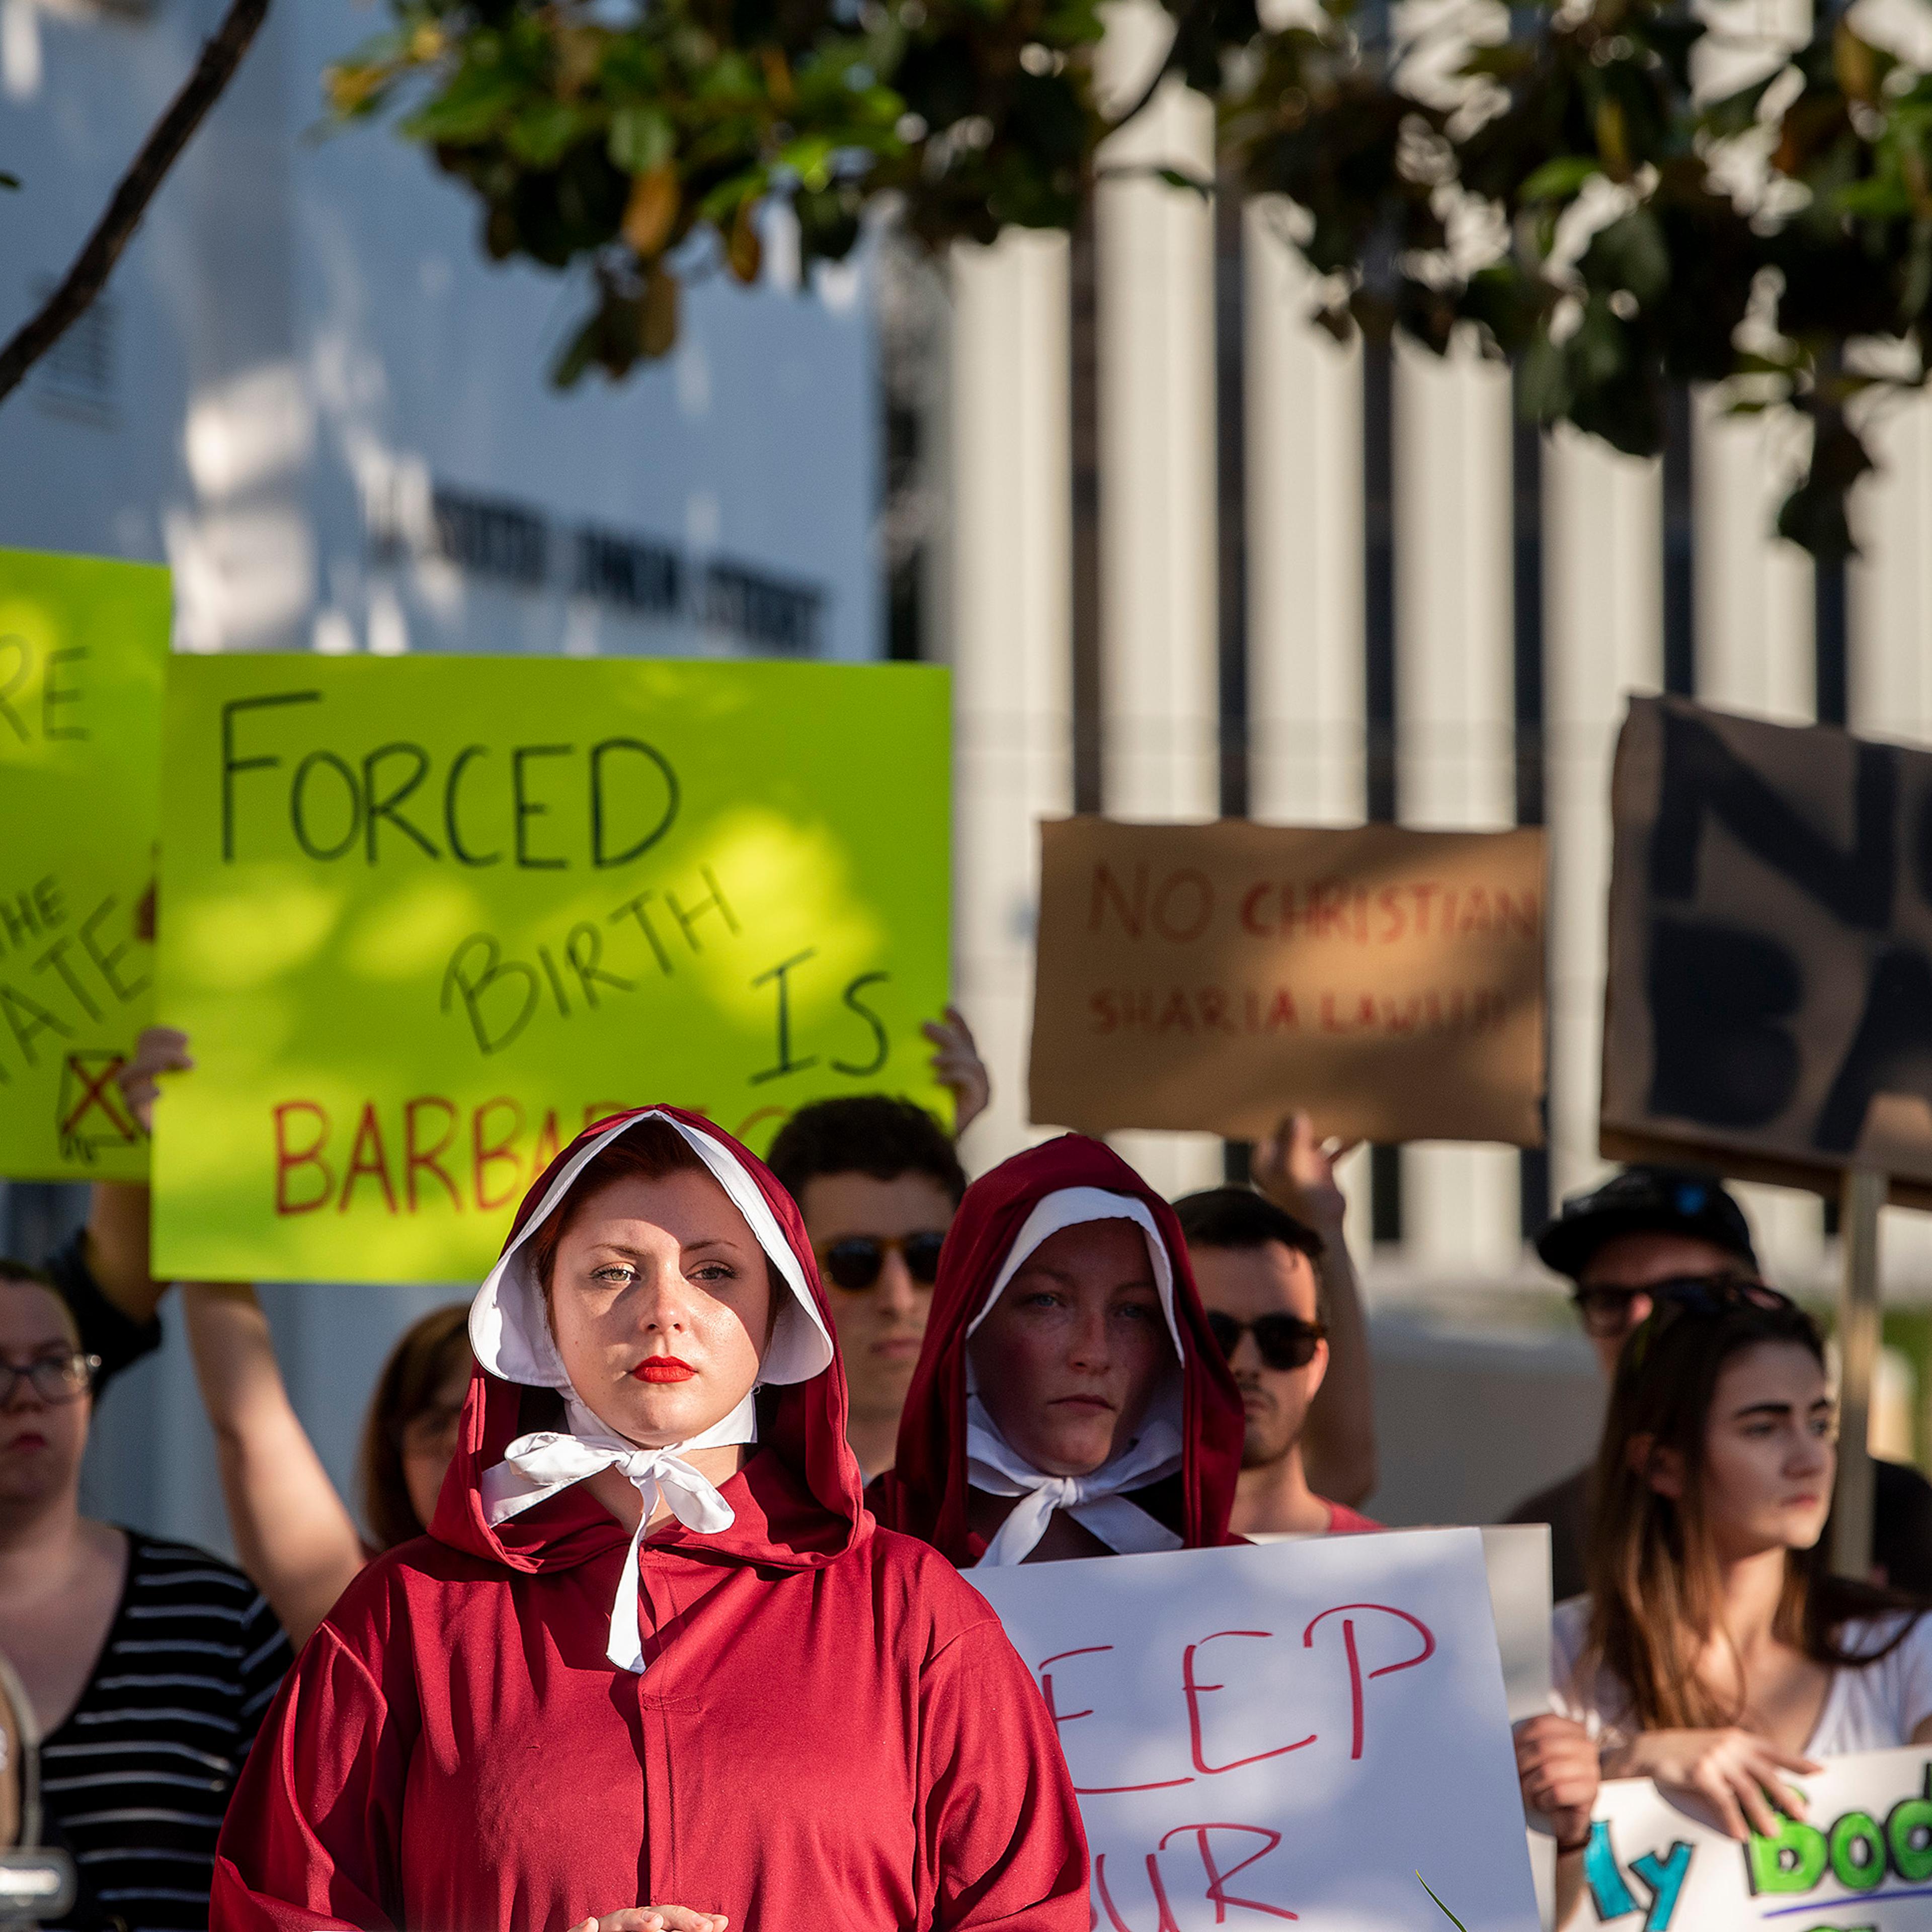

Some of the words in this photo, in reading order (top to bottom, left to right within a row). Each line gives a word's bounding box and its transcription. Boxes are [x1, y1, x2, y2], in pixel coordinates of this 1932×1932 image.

[220, 690, 681, 870] FORCED
[1648, 708, 1932, 935] N
[0, 874, 68, 951] HE
[439, 863, 742, 1057] BIRTH
[1088, 863, 1209, 943] NO
[1239, 873, 1540, 945] CHRISTIAN
[0, 892, 153, 1087] ATE
[749, 948, 891, 1086] IS
[1087, 985, 1301, 1036] SHARIA
[271, 1094, 790, 1220] BARBA
[1038, 1602, 1437, 1795] EEP
[1088, 1821, 1300, 1932] UR
